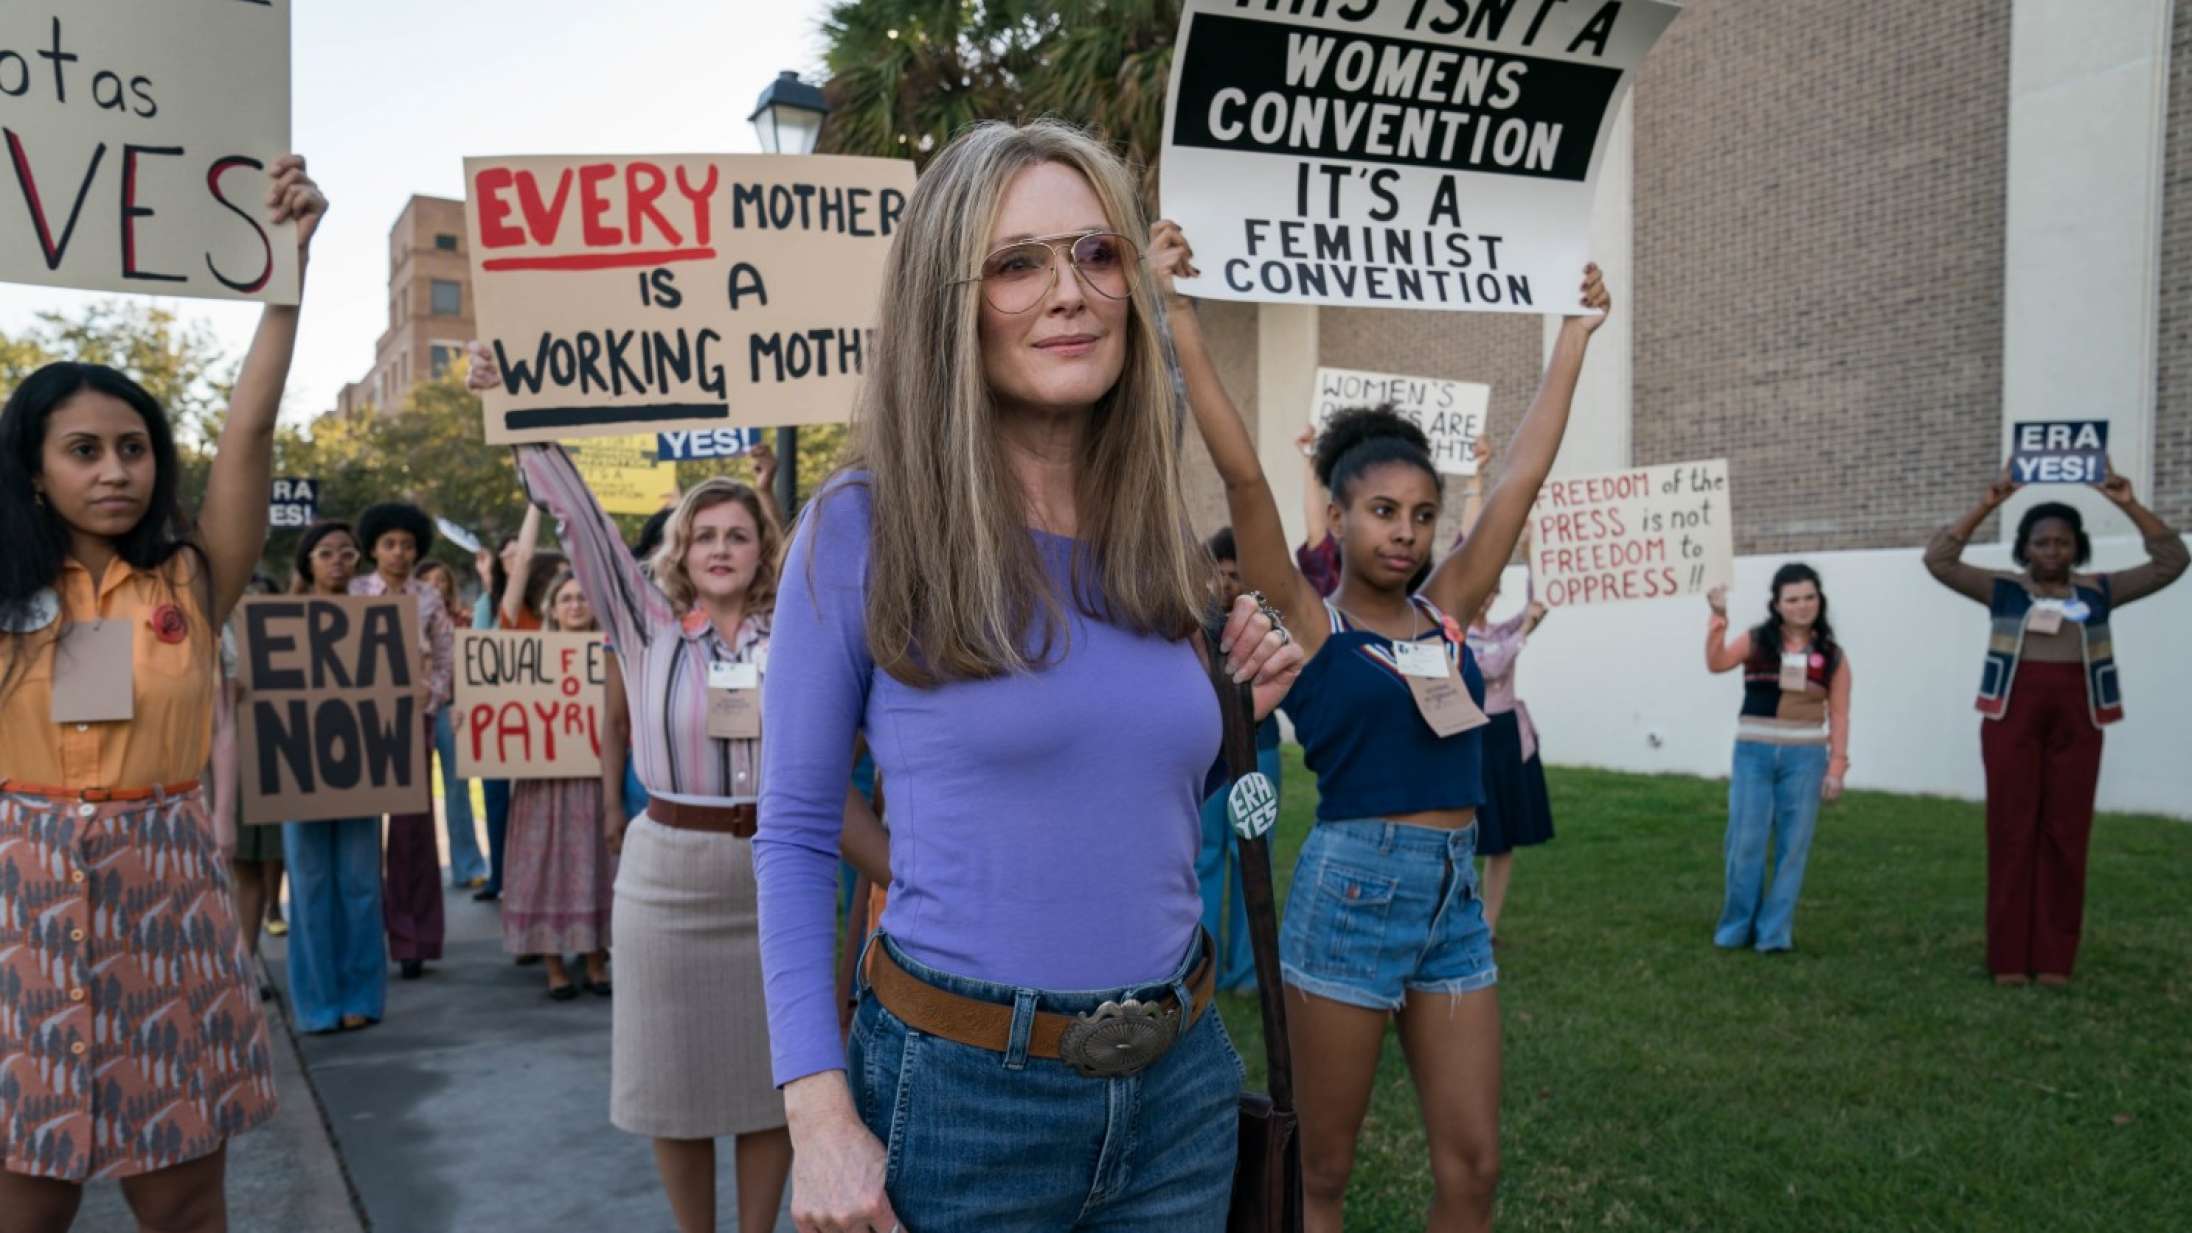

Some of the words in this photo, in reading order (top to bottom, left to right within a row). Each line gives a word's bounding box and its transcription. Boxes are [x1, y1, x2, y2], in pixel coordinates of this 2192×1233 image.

[1404, 0, 1567, 47] ISNT
[1566, 1, 1622, 57] A
[92, 70, 157, 118] as
[1285, 32, 1529, 109] WOMENS
[1208, 86, 1563, 172] CONVENTION
[475, 162, 719, 249] EVERY
[732, 182, 906, 237] MOTHER
[1297, 162, 1401, 222] IT'S
[1428, 174, 1462, 228] A
[1245, 218, 1503, 271] FEMINIST
[639, 267, 683, 309] IS
[728, 262, 768, 310] A
[1224, 258, 1534, 306] CONVENTION
[493, 327, 728, 400] WORKING
[750, 328, 870, 384] MOTH
[1322, 373, 1456, 408] WOMEN'S
[662, 426, 751, 459] YES!
[1430, 411, 1478, 438] ARE
[2020, 422, 2100, 451] ERA
[272, 479, 313, 500] RA
[1536, 472, 1650, 509] FREEDOM
[1661, 468, 1683, 494] of
[1690, 467, 1725, 494] the
[2017, 455, 2097, 481] YES!
[269, 503, 312, 527] ES!
[1540, 507, 1626, 545] PRESS
[1642, 508, 1663, 533] is
[1671, 500, 1711, 529] not
[1540, 538, 1666, 576] FREEDOM
[1680, 534, 1703, 560] to
[1546, 566, 1678, 608] OPPRESS
[245, 601, 411, 691] ERA
[465, 635, 554, 687] EQUAL
[253, 696, 414, 796] NOW
[470, 701, 560, 763] PAY
[1231, 773, 1272, 820] ERA
